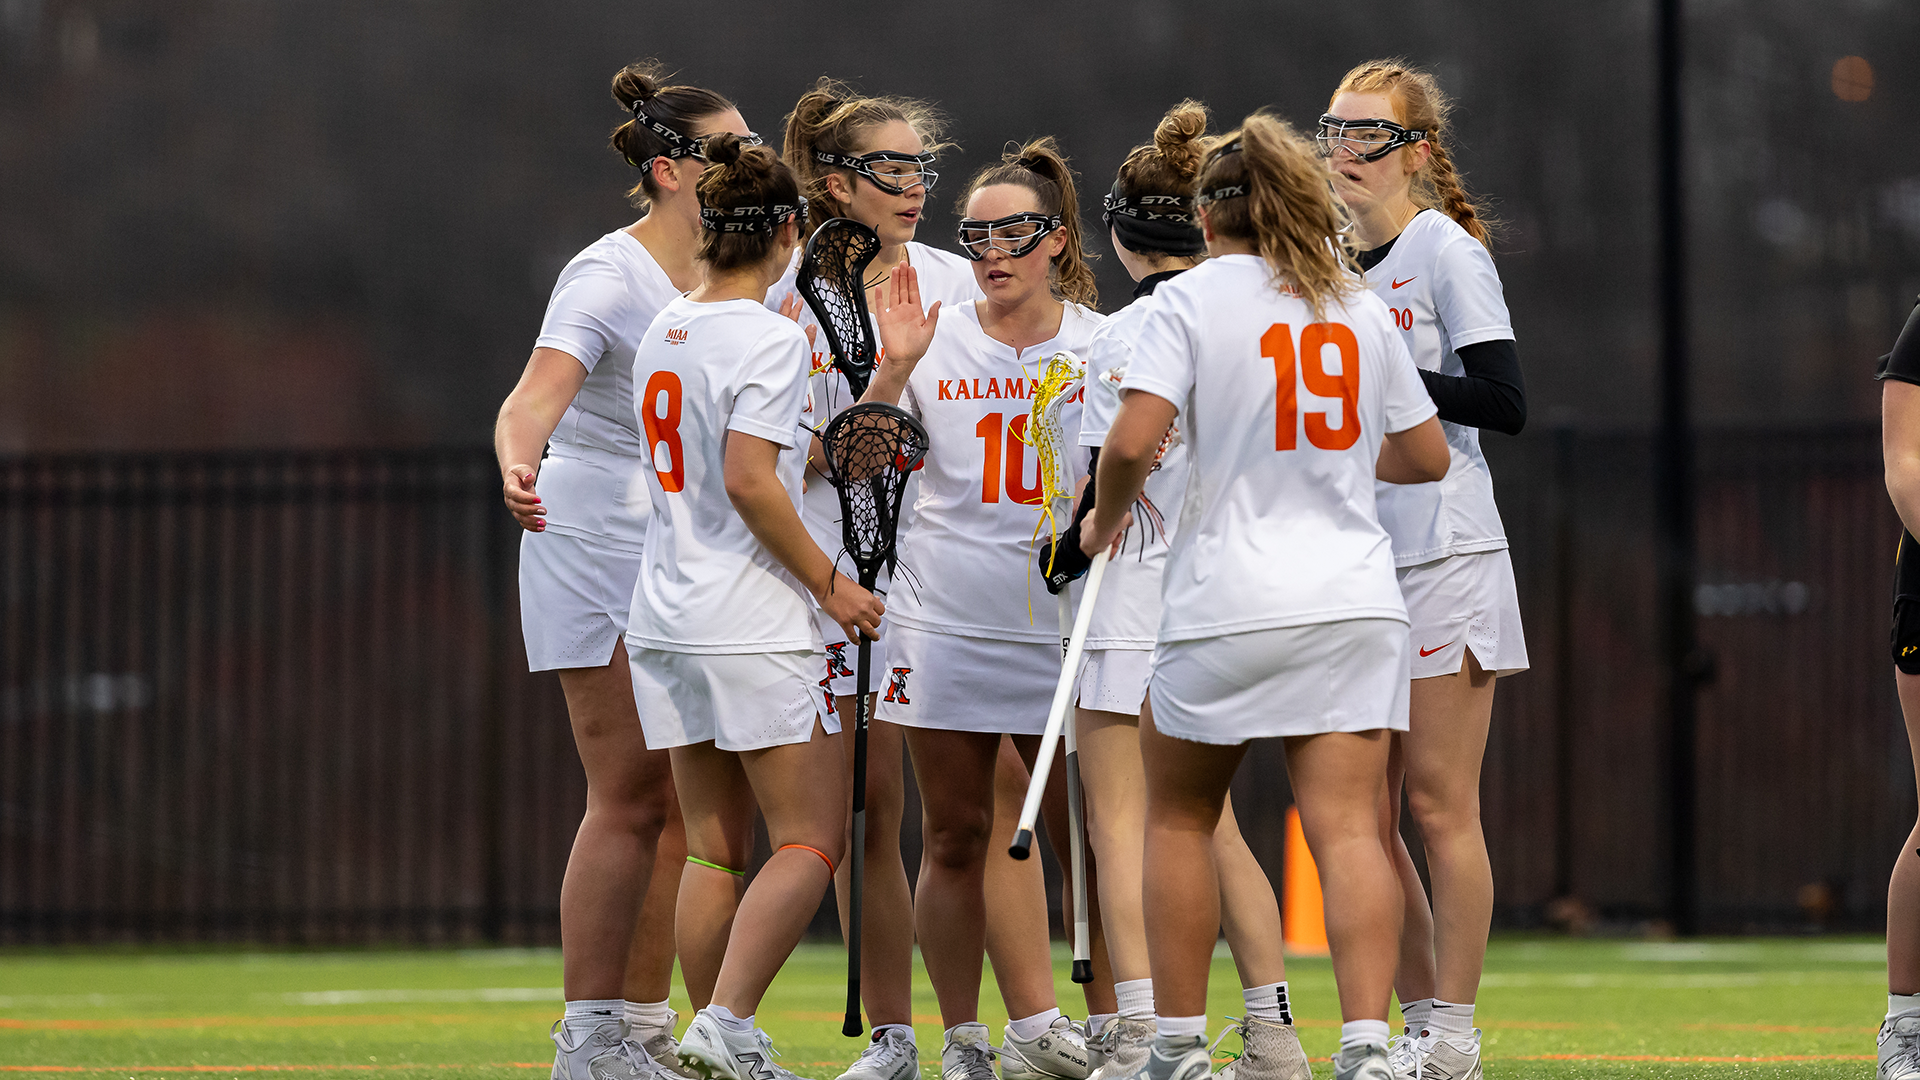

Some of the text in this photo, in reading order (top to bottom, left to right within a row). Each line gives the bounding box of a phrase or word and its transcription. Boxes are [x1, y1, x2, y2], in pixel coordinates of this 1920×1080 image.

[652, 121, 683, 143] STX
[1410, 131, 1424, 140] STX
[641, 154, 660, 173] ST
[816, 151, 835, 163] STX
[842, 156, 861, 169] TX
[1215, 185, 1244, 200] STX
[1140, 195, 1181, 206] STX
[703, 208, 724, 217] STX
[733, 206, 765, 216] STX
[666, 328, 688, 341] MIAA
[1260, 322, 1361, 451] 19
[642, 371, 684, 493] 8
[976, 412, 1044, 505] 10
[1052, 571, 1069, 586] STX
